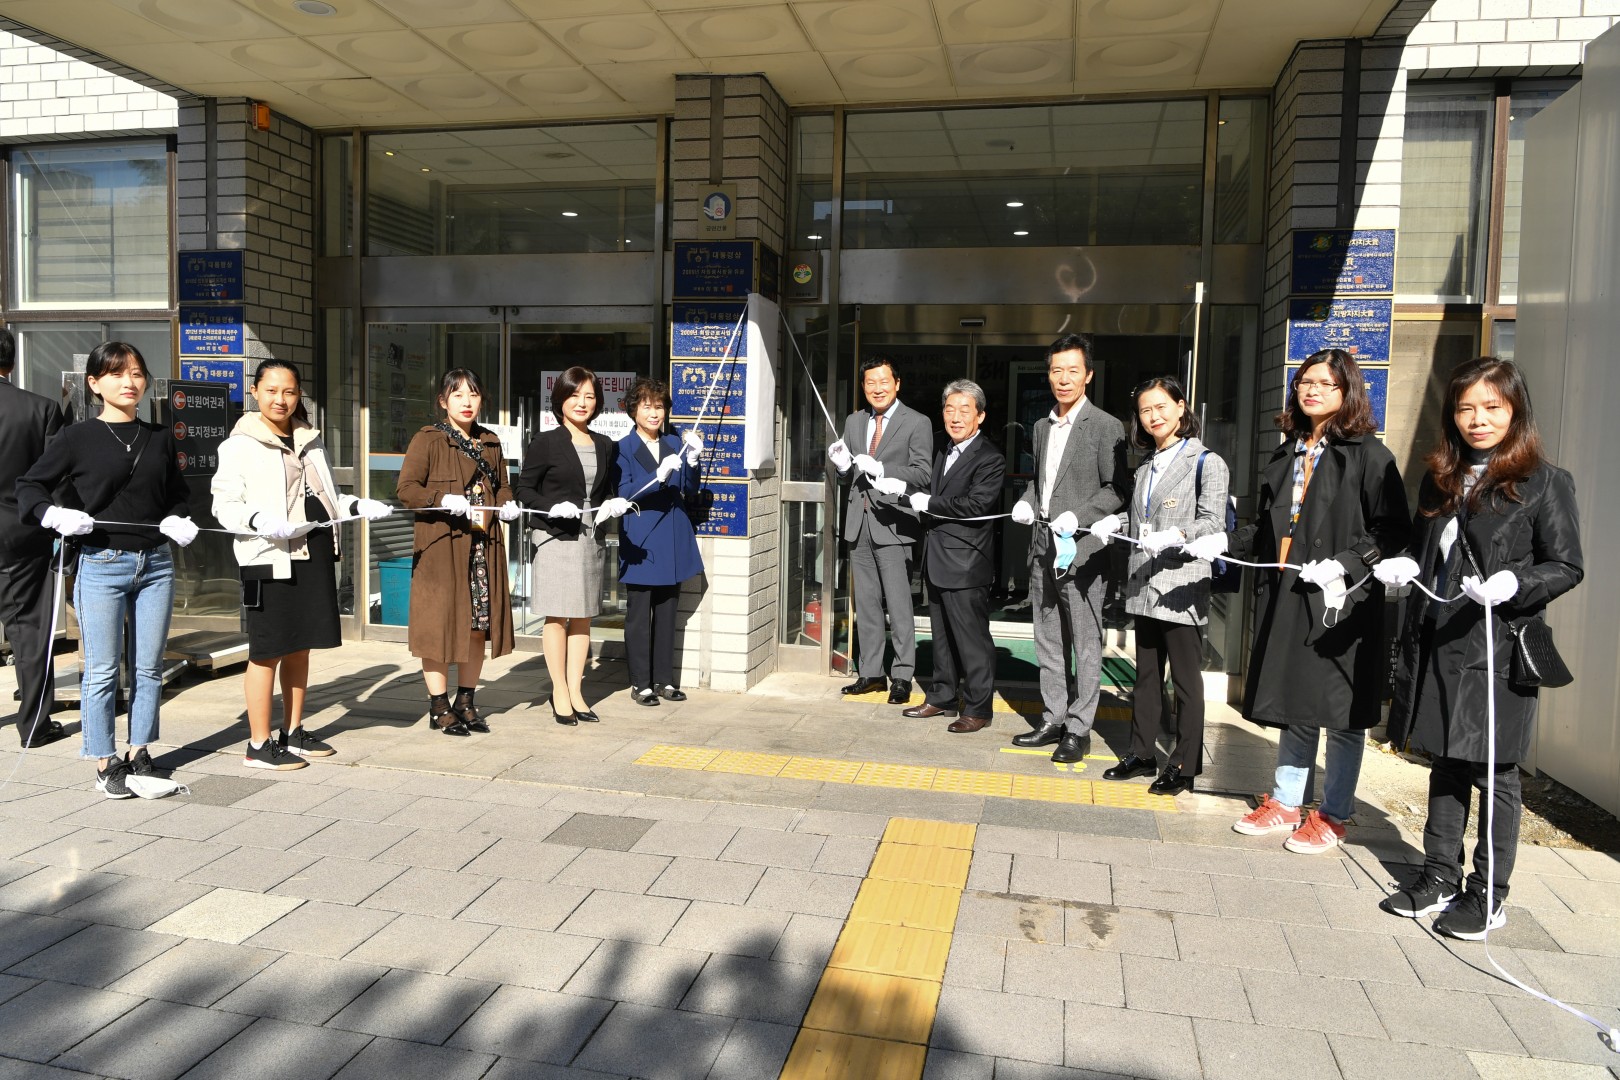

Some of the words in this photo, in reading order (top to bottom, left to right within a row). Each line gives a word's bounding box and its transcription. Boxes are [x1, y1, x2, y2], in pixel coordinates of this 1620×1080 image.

[712, 250, 742, 260] 대통령상
[208, 260, 233, 269] 대통령상
[209, 316, 234, 324] 대통령상
[710, 312, 740, 320] 대통령상
[209, 369, 235, 378] 대통령상
[186, 394, 225, 410] 민원여권과
[187, 426, 226, 439] 토지정보과
[707, 433, 738, 443] 대통령상
